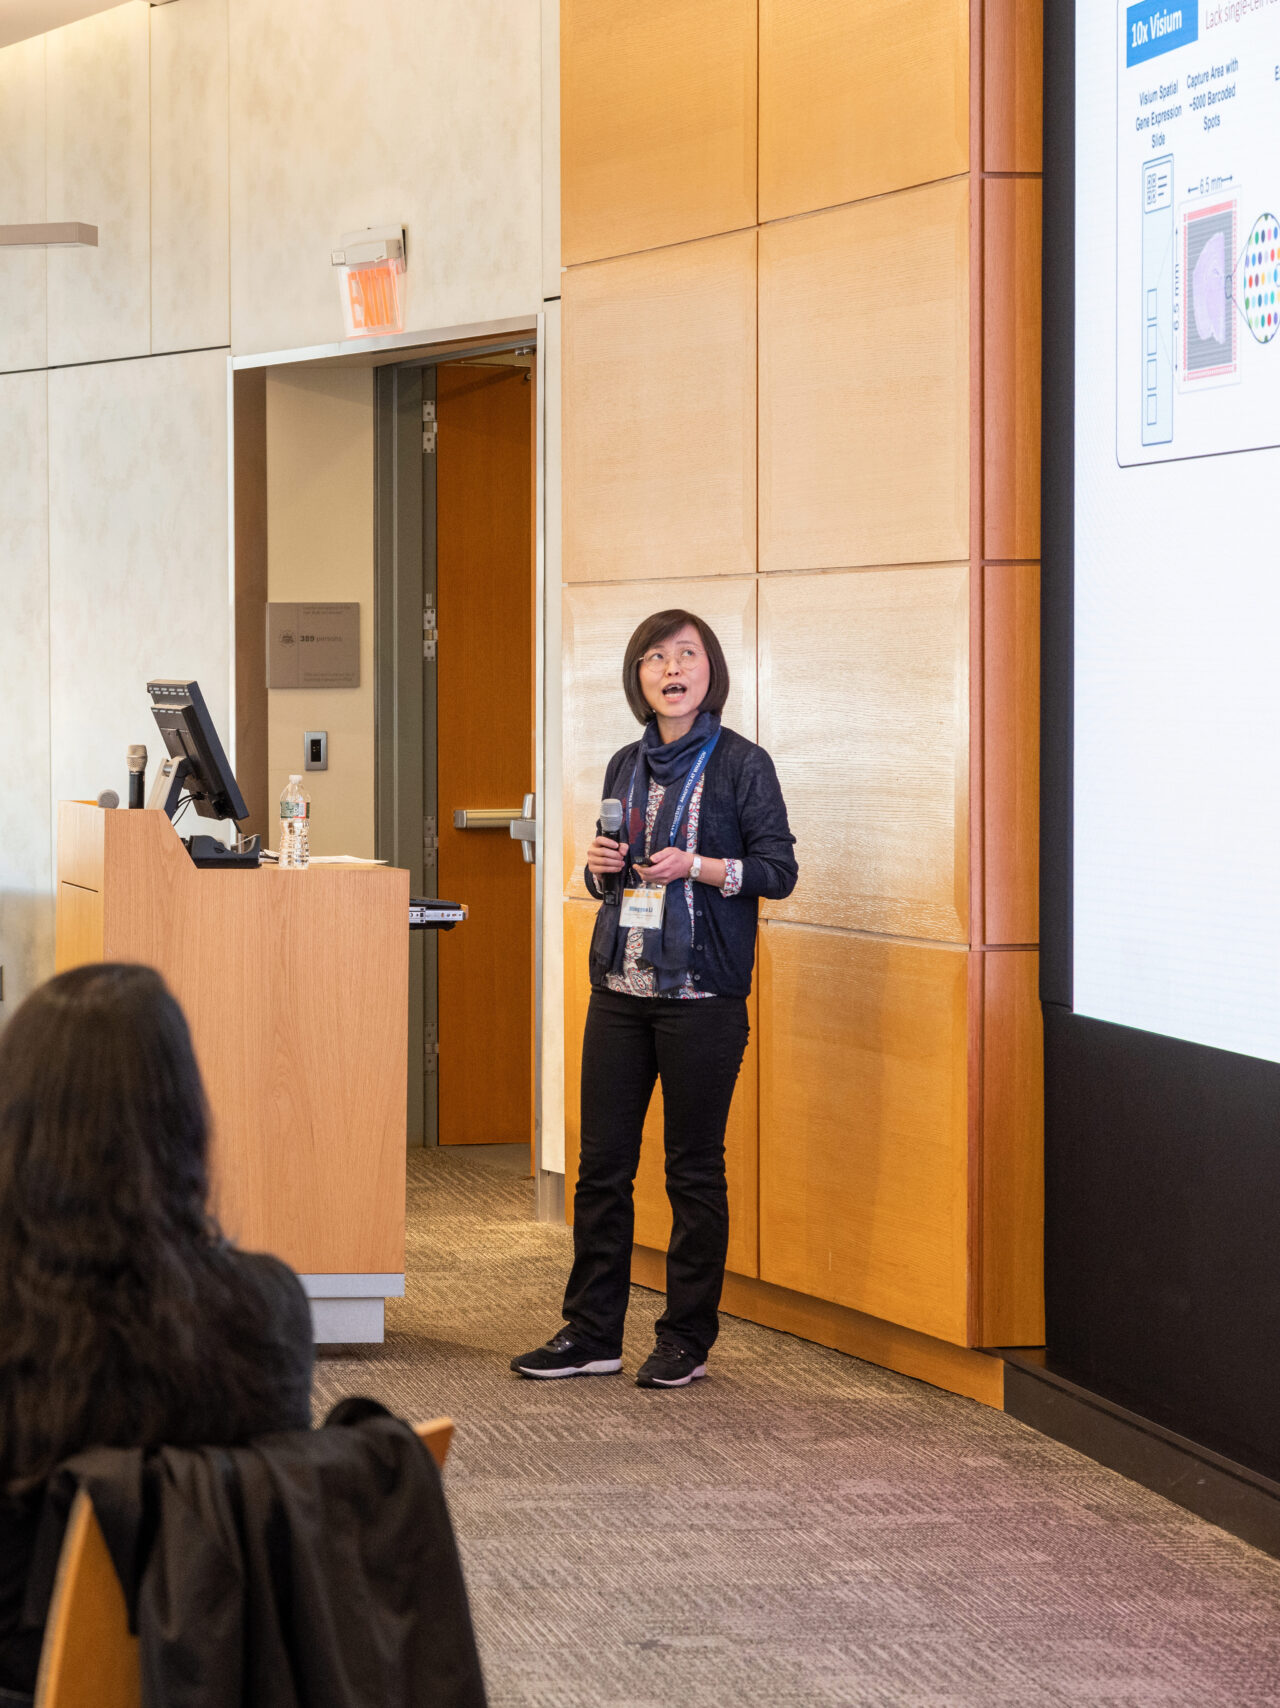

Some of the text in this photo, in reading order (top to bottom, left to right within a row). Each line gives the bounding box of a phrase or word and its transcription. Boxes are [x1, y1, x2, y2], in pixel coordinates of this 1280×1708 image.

[1131, 9, 1183, 48] 10x Visium
[1205, 4, 1223, 30] Lack
[1186, 57, 1239, 90] Capture Area with
[1139, 80, 1179, 107] Visium Spatial
[1207, 82, 1236, 106] Barcoded
[1136, 104, 1182, 131] Gene Expression
[1203, 114, 1221, 132] Spots
[1151, 131, 1166, 148] Slide
[347, 267, 392, 329] EXIT
